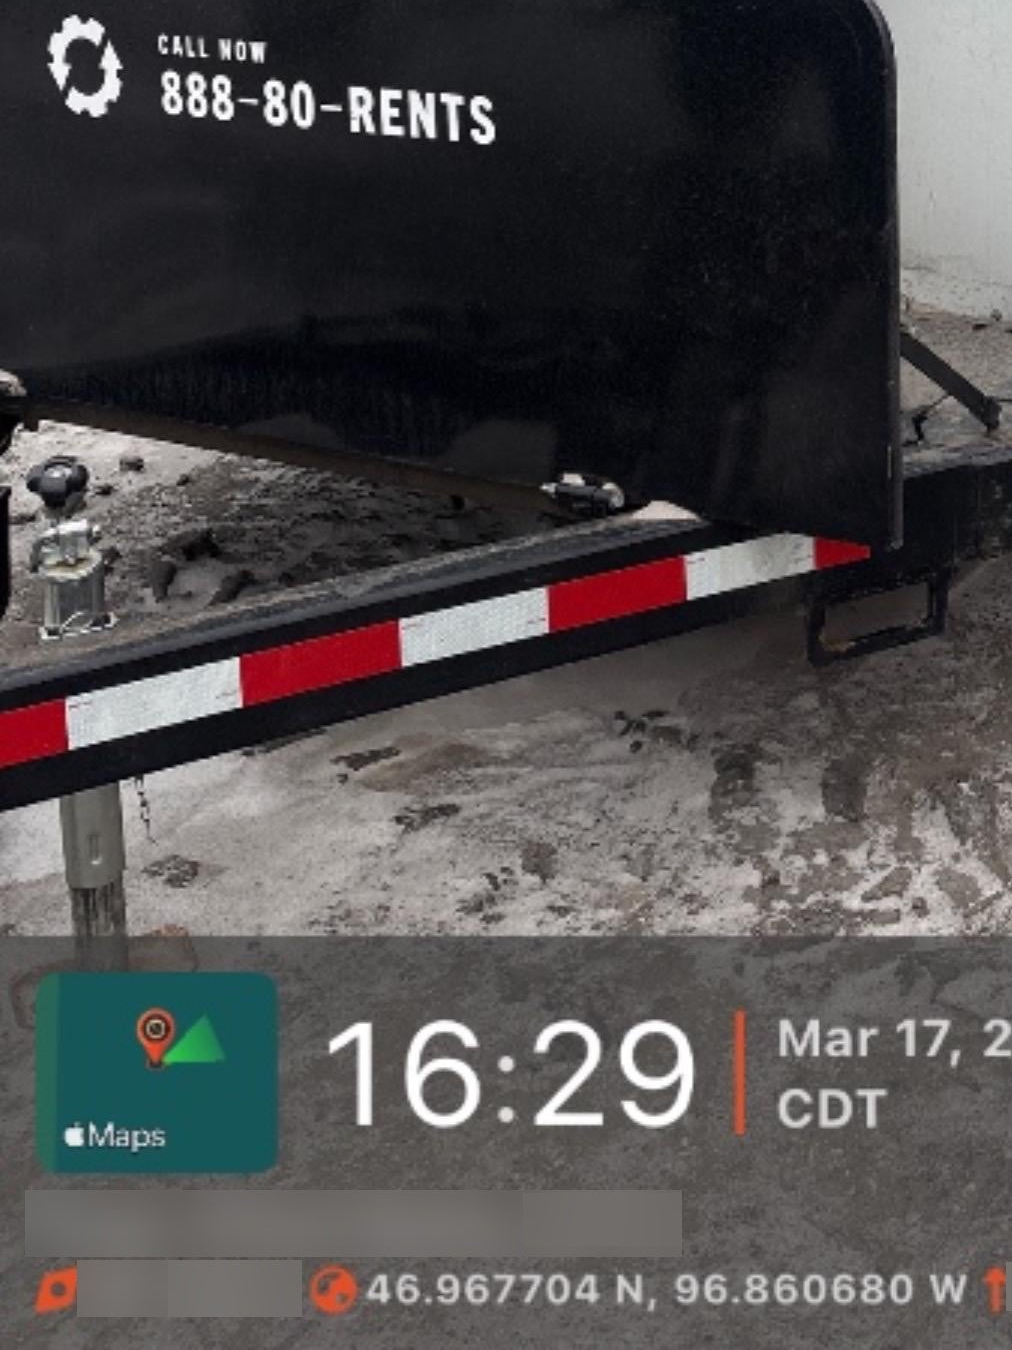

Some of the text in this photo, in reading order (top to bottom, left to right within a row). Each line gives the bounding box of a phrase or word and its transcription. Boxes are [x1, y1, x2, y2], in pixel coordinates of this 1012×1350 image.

[157, 33, 267, 64] CALL NOW
[160, 69, 496, 145] 888-80-RENTS
